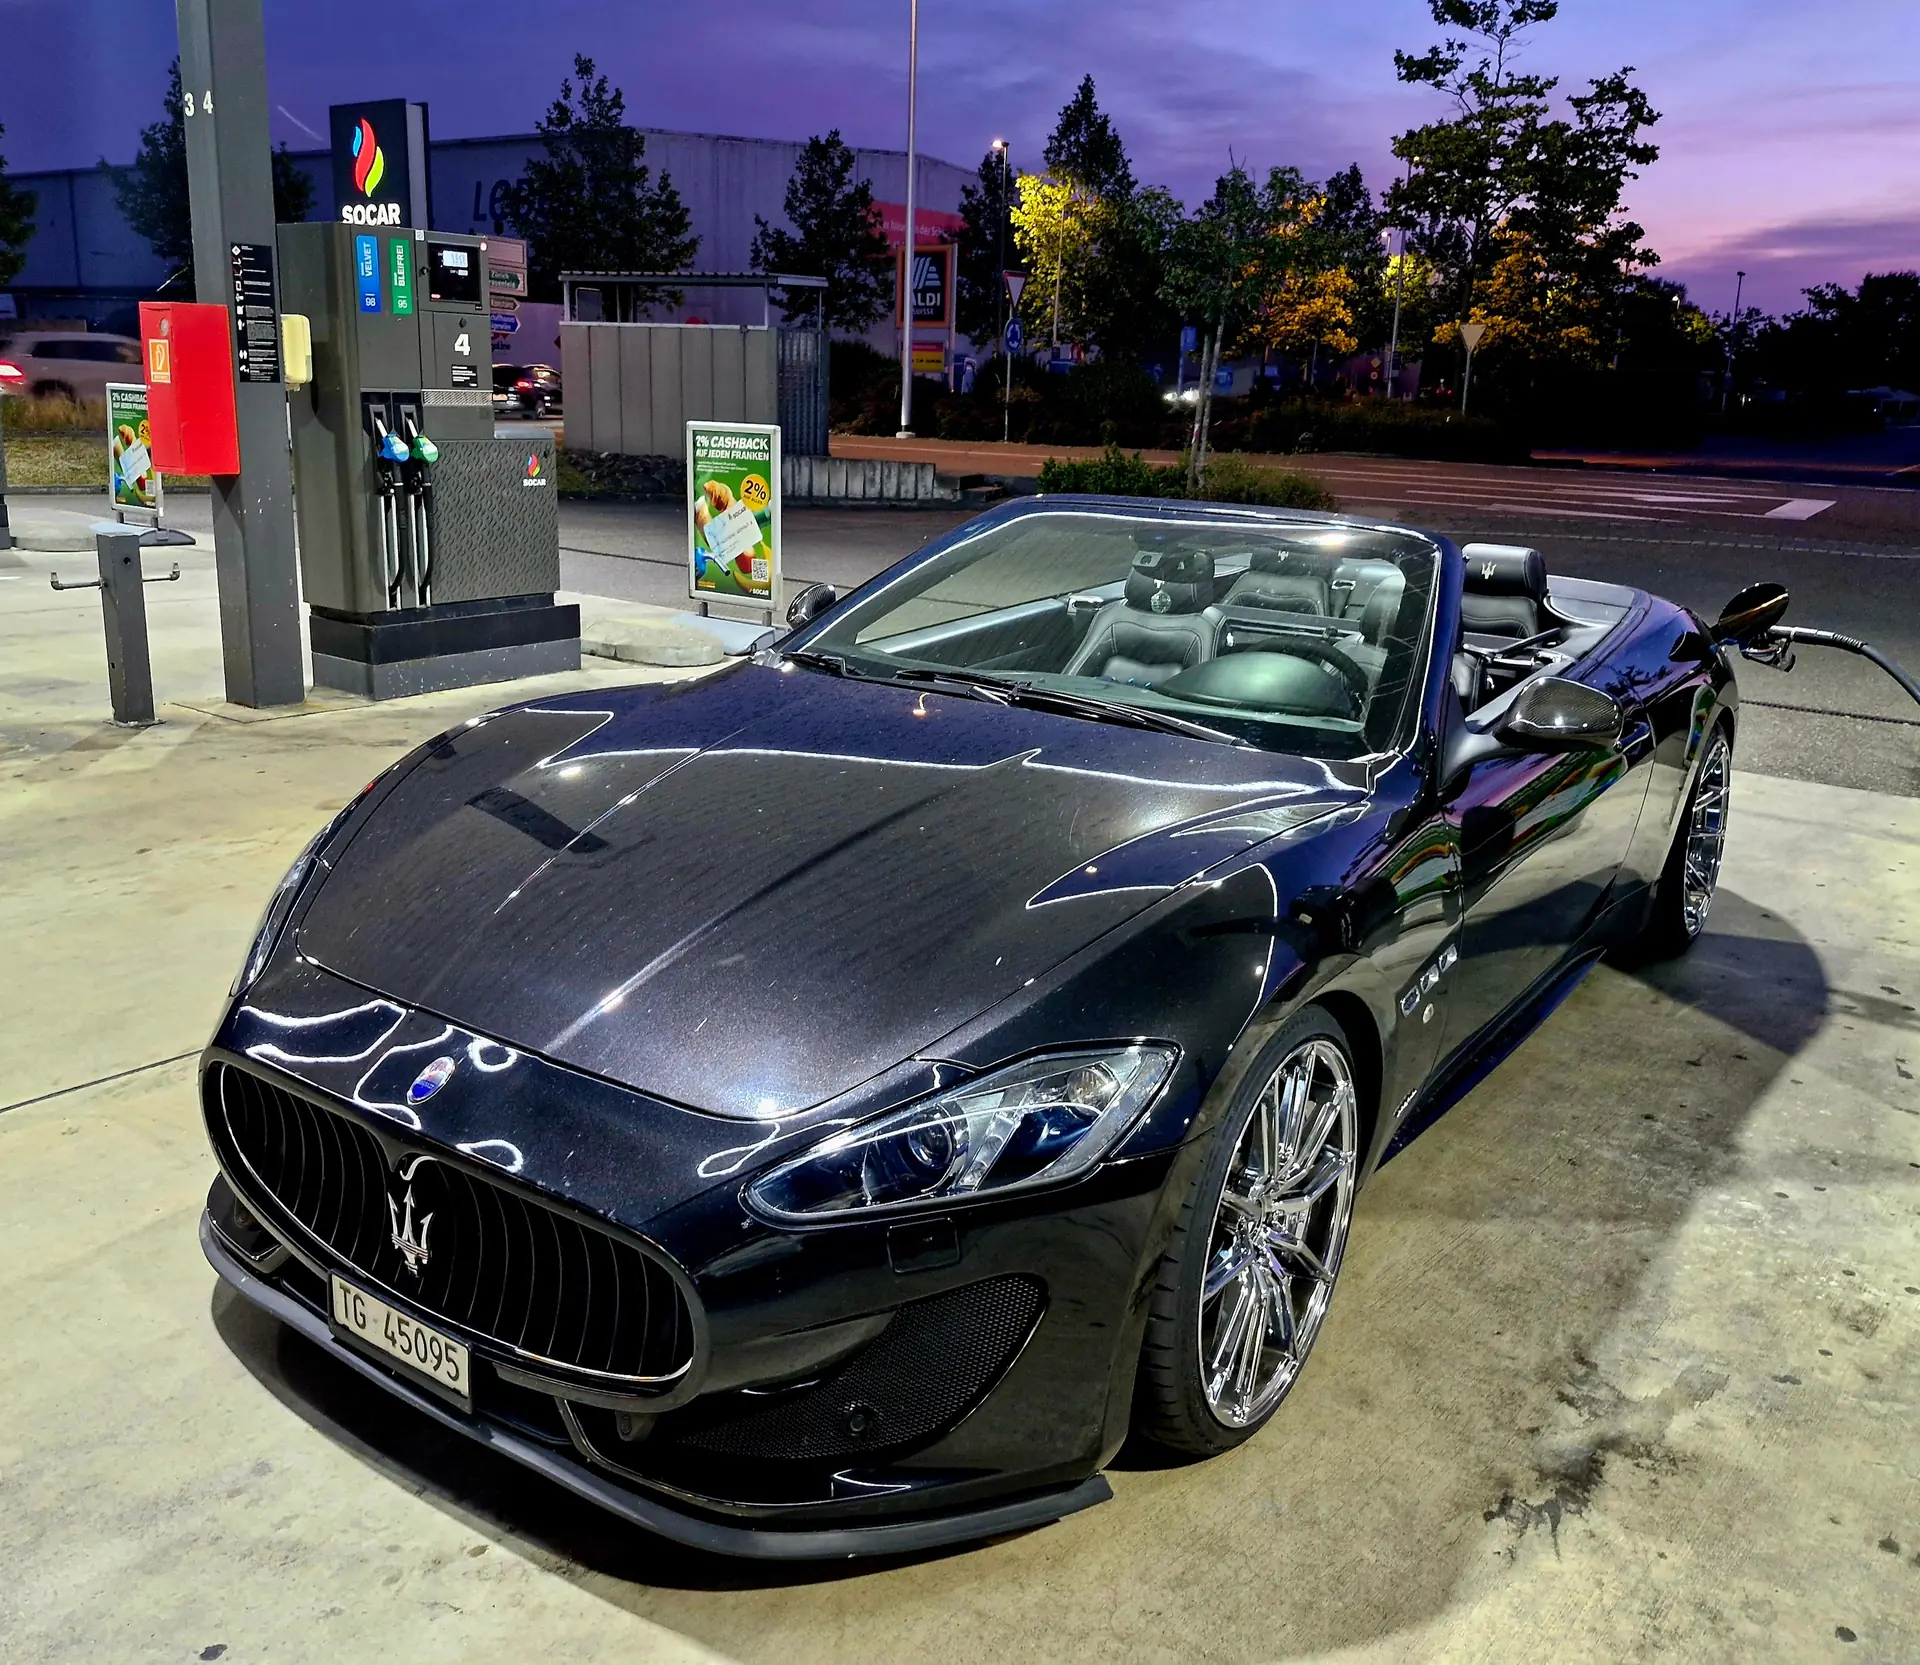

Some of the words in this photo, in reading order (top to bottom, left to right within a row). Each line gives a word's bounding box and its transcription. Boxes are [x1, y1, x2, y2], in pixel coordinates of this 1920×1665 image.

[185, 92, 195, 117] 3
[203, 90, 214, 115] 4
[341, 203, 401, 226] SOCAR
[363, 242, 372, 278] VELVET
[396, 245, 406, 287] BLEIFREI
[365, 296, 376, 307] 98
[397, 299, 408, 309] 95
[454, 333, 471, 356] 4
[121, 393, 148, 403] CASHBAC
[695, 435, 709, 448] 2%
[710, 436, 769, 450] CASHBACK
[696, 449, 708, 458] AUF
[708, 449, 730, 459] JEDEN
[731, 451, 769, 461] FRANKEN
[523, 478, 546, 487] SOCAR
[744, 479, 767, 501] 2%
[733, 506, 747, 519] SOCAR
[752, 588, 769, 596] SOCAR
[339, 1283, 367, 1330] TG
[384, 1311, 460, 1382] 45095
